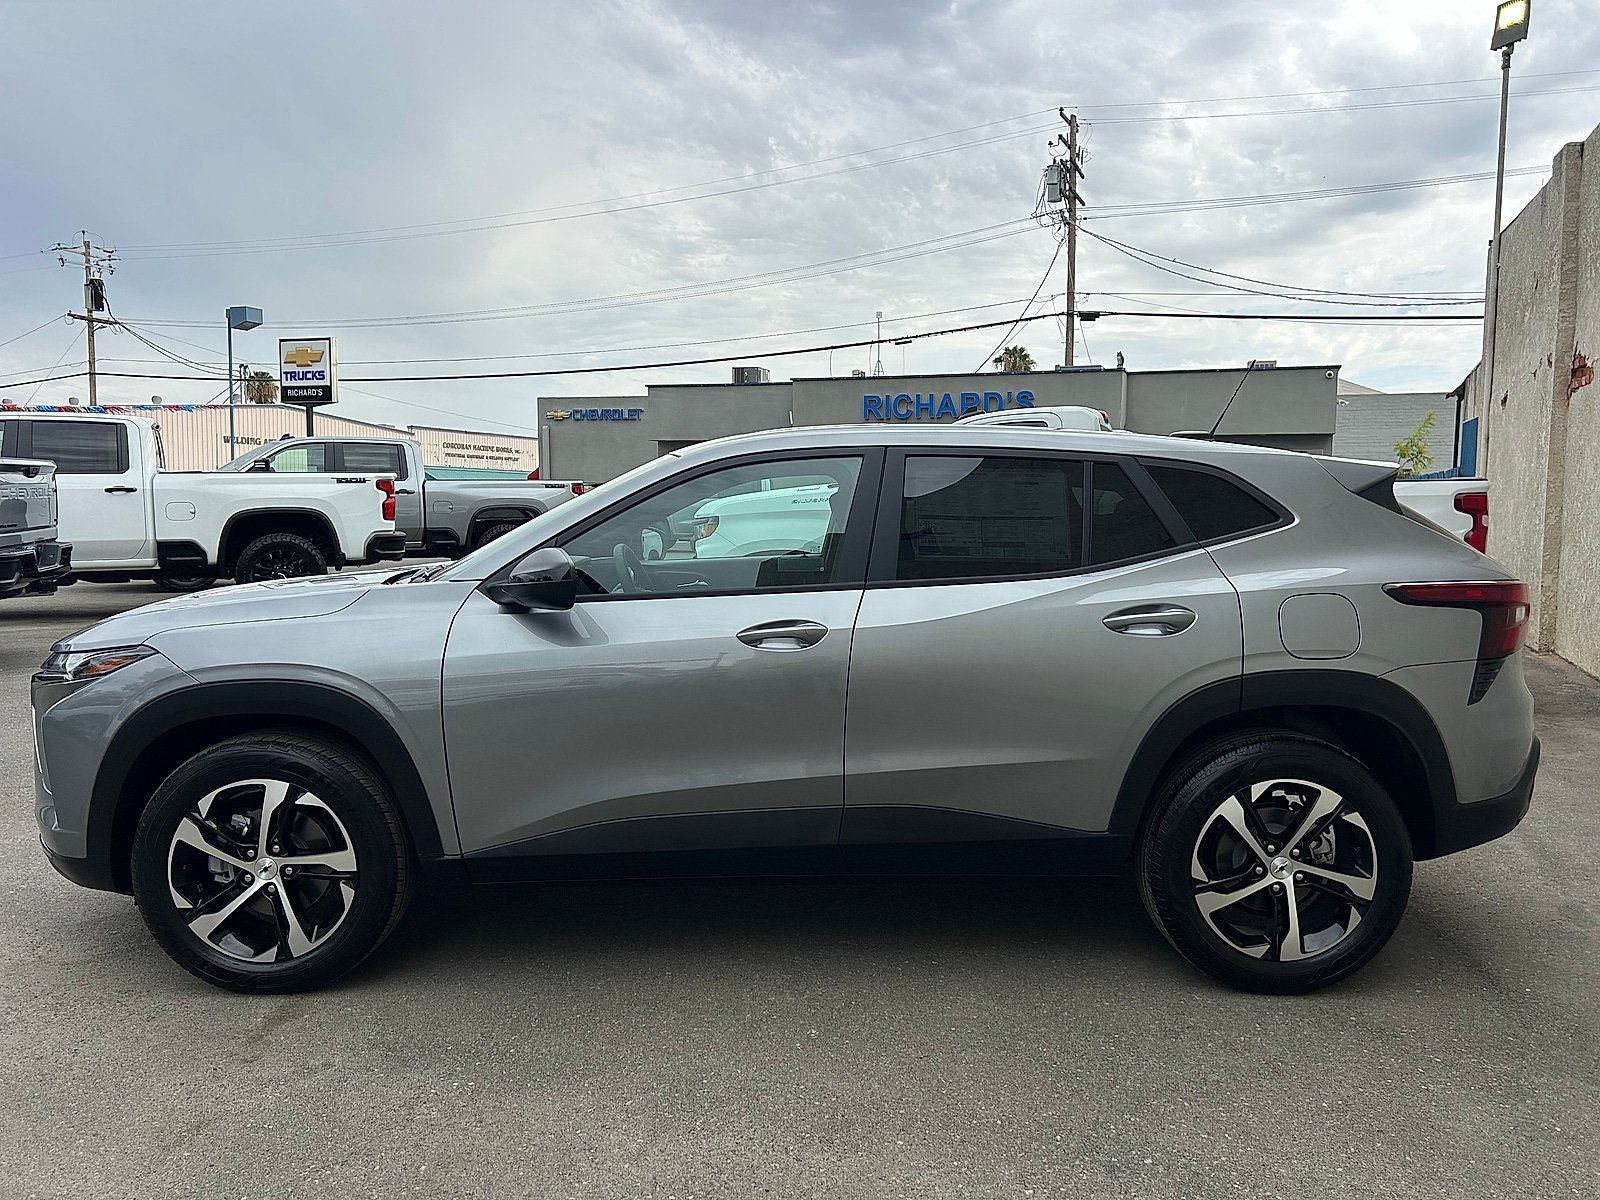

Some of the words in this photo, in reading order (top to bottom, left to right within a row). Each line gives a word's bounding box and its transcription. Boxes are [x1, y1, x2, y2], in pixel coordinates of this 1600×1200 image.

[283, 370, 326, 381] TRUCKS
[287, 388, 323, 397] RICHARD'S
[863, 390, 1036, 420] RICHARD'S
[572, 408, 644, 421] CHEVROLET
[222, 435, 262, 446] WLDING
